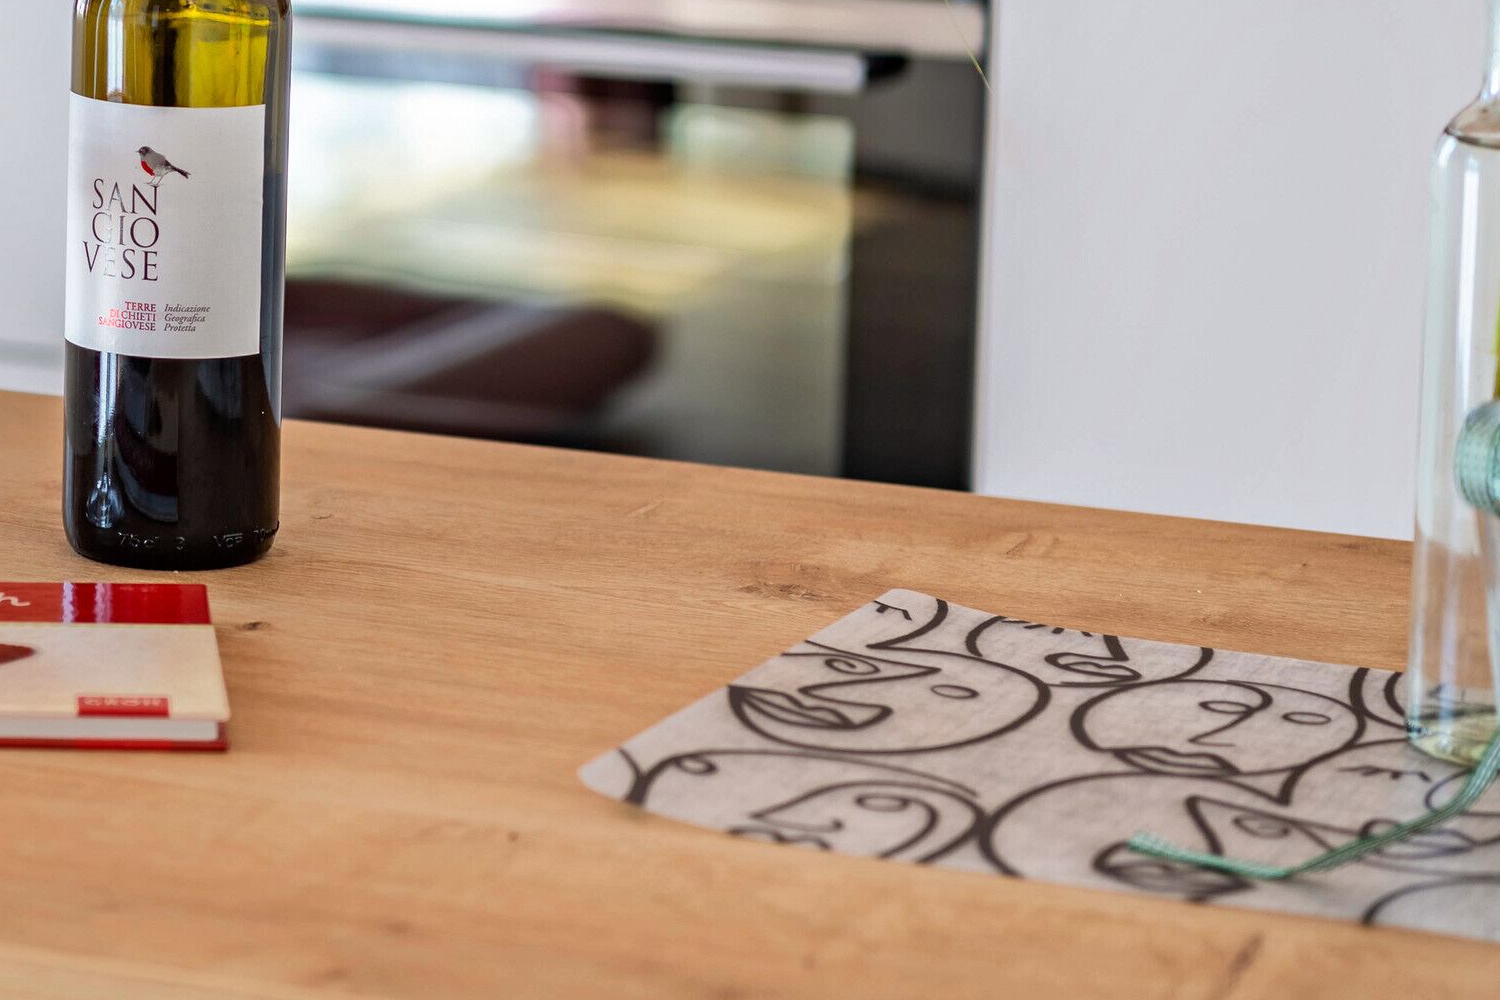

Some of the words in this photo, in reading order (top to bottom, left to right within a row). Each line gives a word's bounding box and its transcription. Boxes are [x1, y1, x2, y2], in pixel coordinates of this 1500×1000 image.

[92, 178, 159, 215] SAN
[92, 212, 159, 248] GIO
[83, 241, 159, 281] VESE
[125, 301, 156, 313] TERRE
[164, 303, 211, 313] Indicazione
[110, 309, 119, 319] DI
[121, 311, 156, 322] CHIETI
[164, 312, 206, 325] Geografica
[98, 316, 156, 331] SANGIOVESE
[164, 323, 197, 332] Protetta
